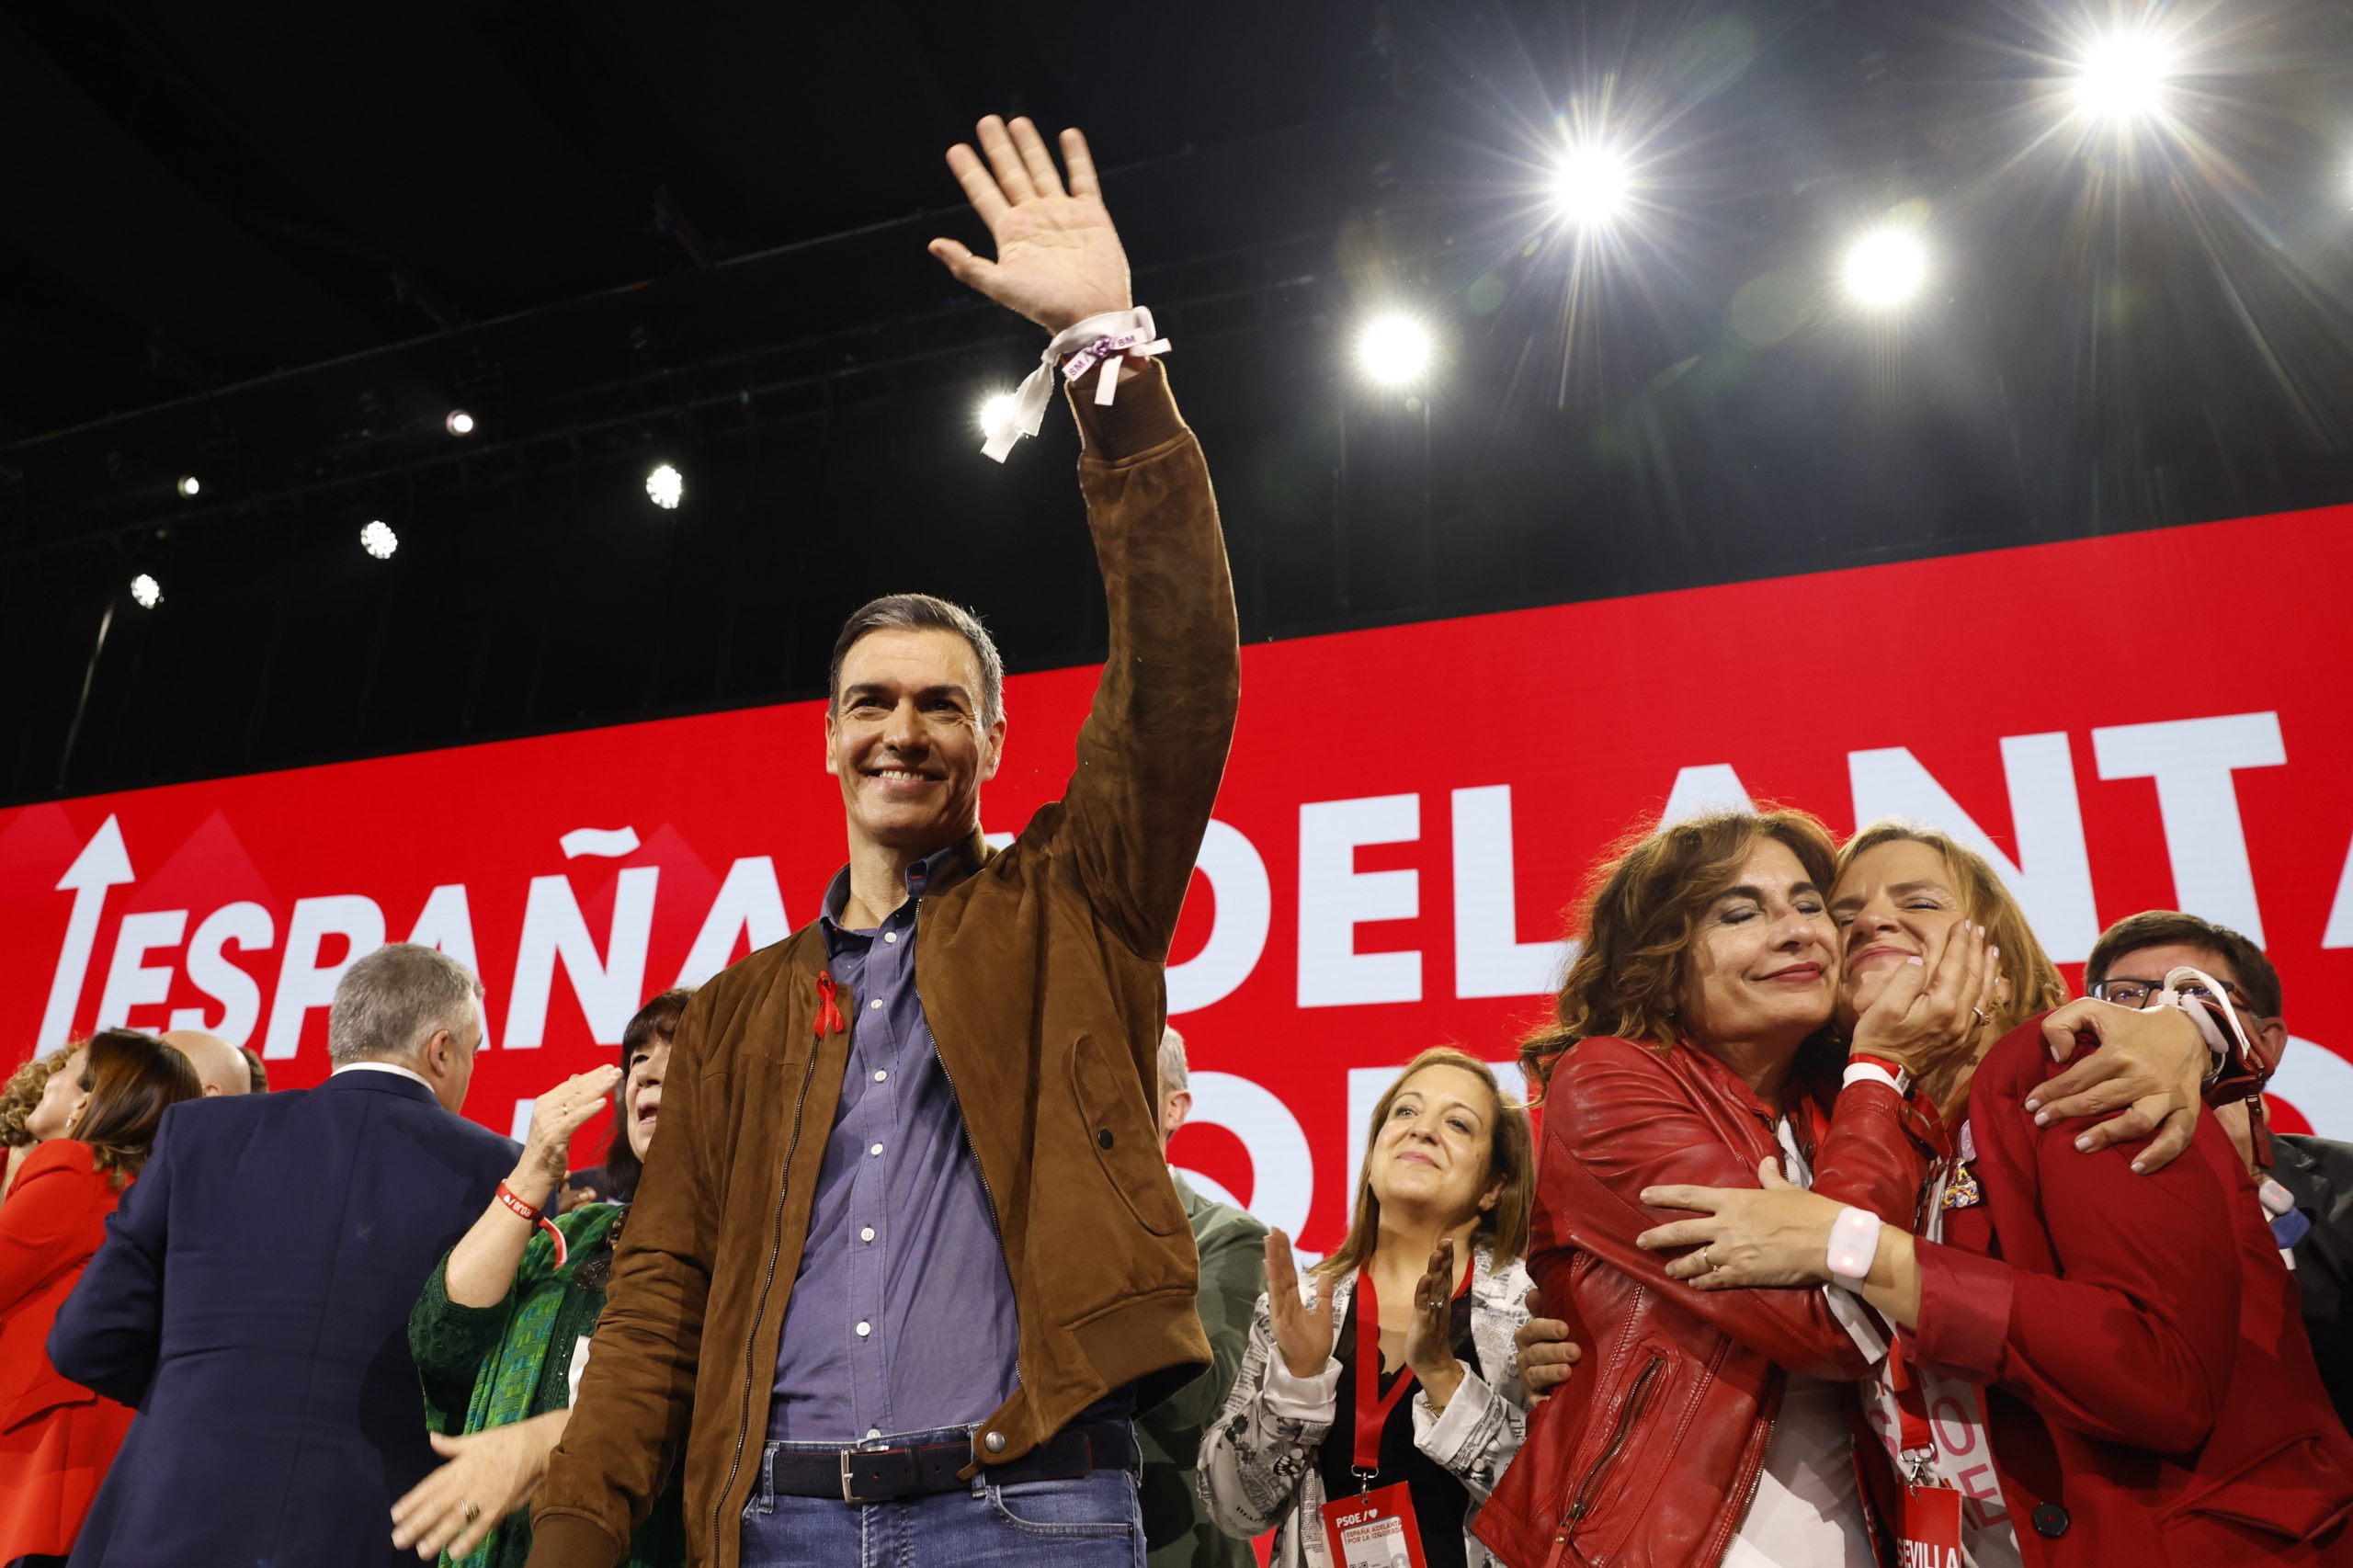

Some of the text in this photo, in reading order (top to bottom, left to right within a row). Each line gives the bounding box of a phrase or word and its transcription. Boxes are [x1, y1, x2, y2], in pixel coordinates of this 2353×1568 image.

[1118, 335, 1136, 347] 8M
[1336, 1512, 1361, 1528] PSOE
[1896, 1537, 1959, 1568] SEVILLA
